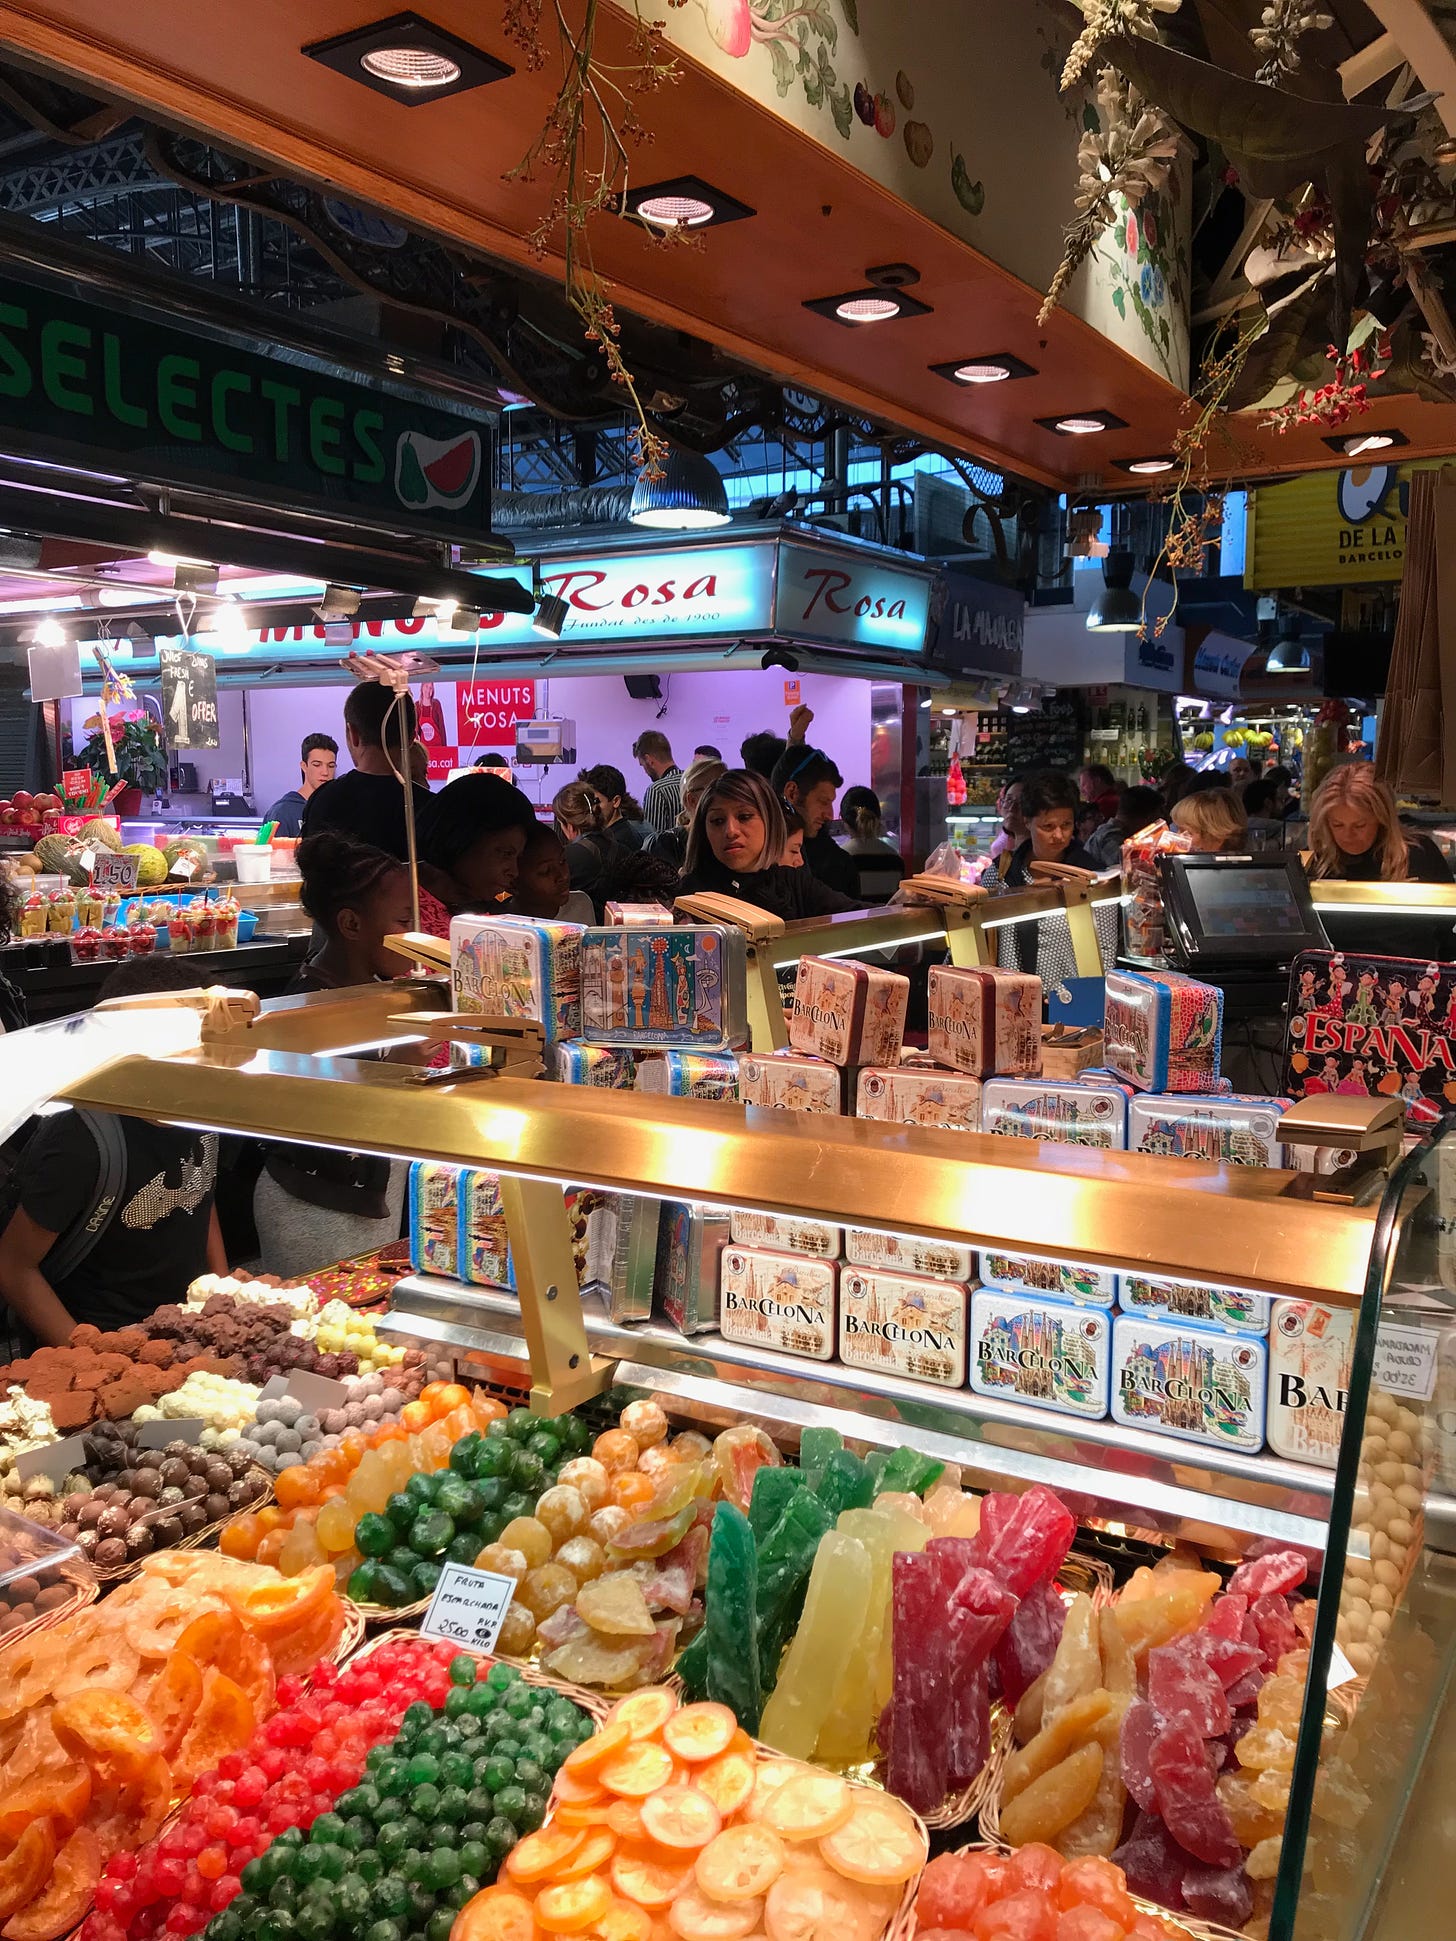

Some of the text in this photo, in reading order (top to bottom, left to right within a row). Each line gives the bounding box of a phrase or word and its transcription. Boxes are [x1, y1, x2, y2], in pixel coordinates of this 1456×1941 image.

[0, 304, 386, 483] SELECTES
[1339, 528, 1363, 548] DE
[1372, 526, 1396, 546] LA
[1339, 550, 1403, 564] BARCELO
[542, 570, 717, 611] Rosa
[802, 568, 906, 620] Rosa
[686, 612, 720, 622] 1900
[191, 700, 217, 723] OFFER
[461, 687, 531, 706] MENUTS
[473, 711, 518, 729] ROSA
[427, 758, 453, 768] sa.cat
[453, 969, 536, 1007] BARCELONA
[794, 998, 847, 1032] BARCELONA
[929, 1010, 978, 1041] BARCELONA
[1304, 1011, 1456, 1072] ESPAÑA
[726, 1291, 826, 1325] BARCELONA
[845, 1315, 956, 1351] BARCELONA
[978, 1340, 1098, 1381] BARCELONA
[1120, 1368, 1254, 1413] BARCELONA
[454, 1576, 485, 1589] FRUTA
[470, 1637, 491, 1649] KILO
